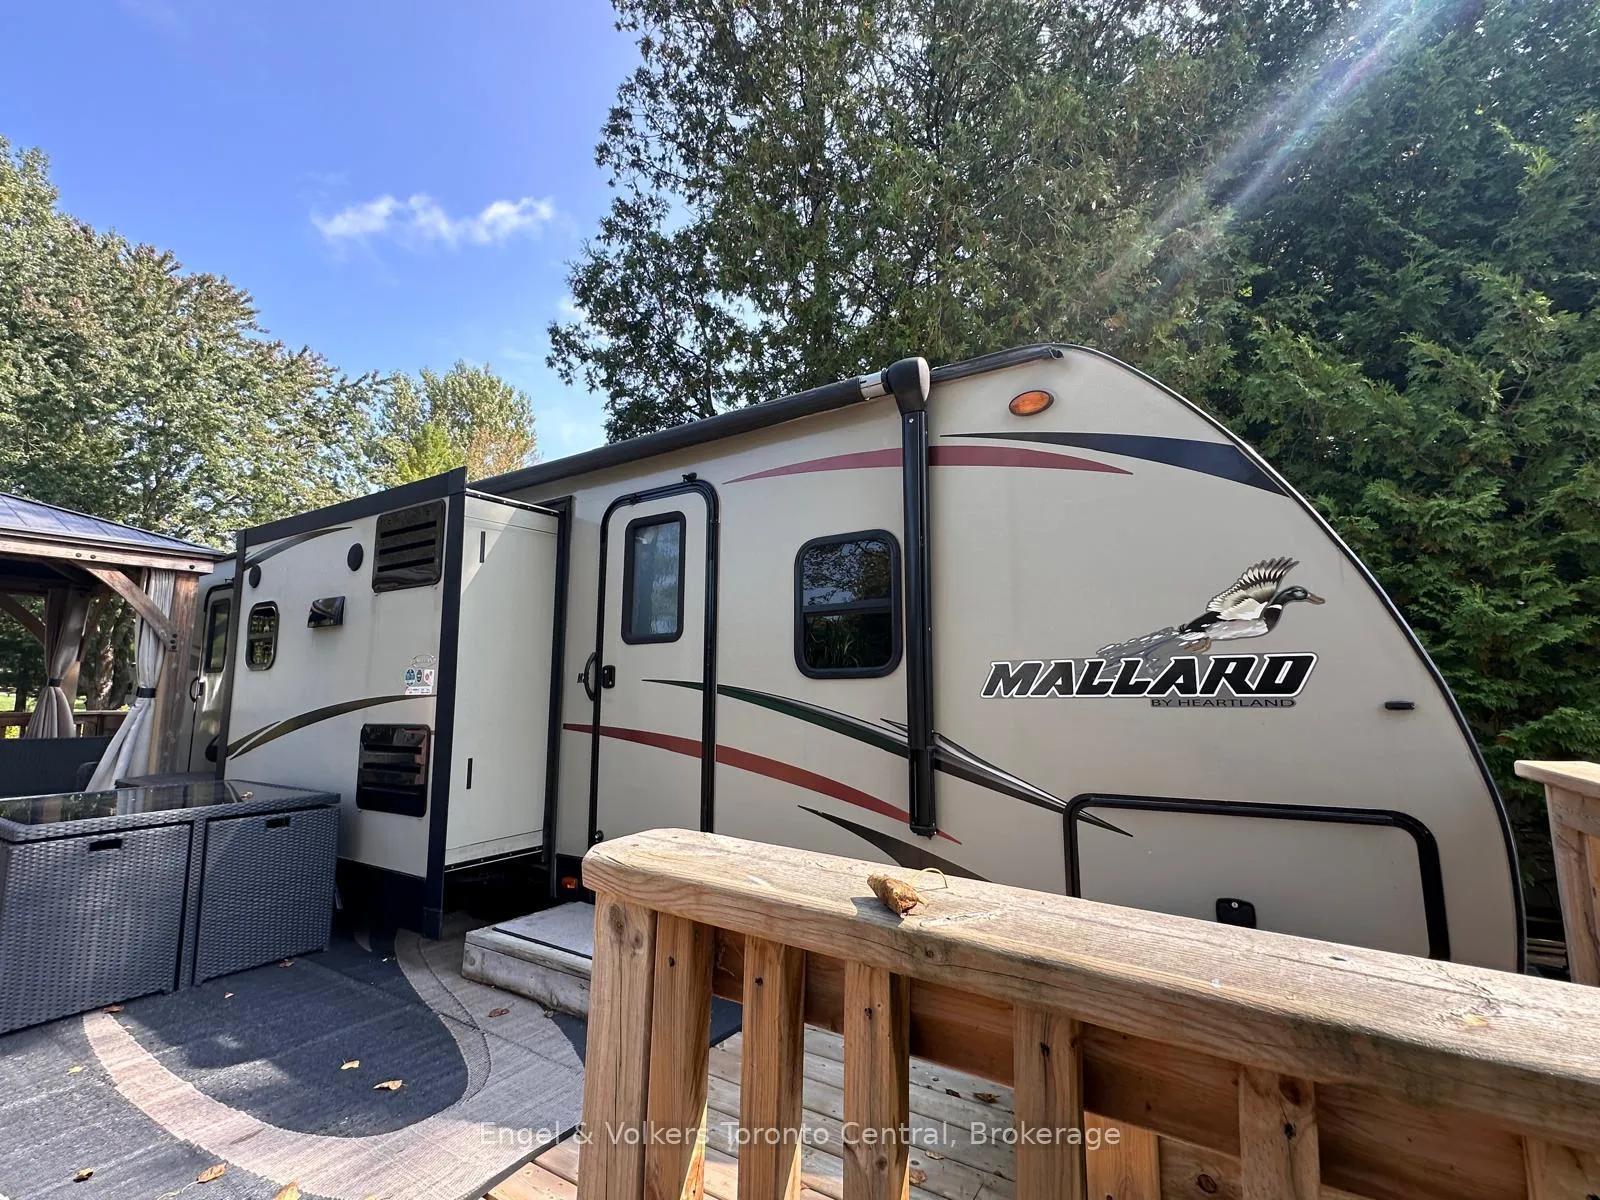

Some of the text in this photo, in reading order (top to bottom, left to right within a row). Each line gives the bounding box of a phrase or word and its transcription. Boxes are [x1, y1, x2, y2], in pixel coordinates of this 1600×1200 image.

[981, 652, 1318, 698] MALLARD
[1151, 699, 1296, 707] BY HEARTLAND
